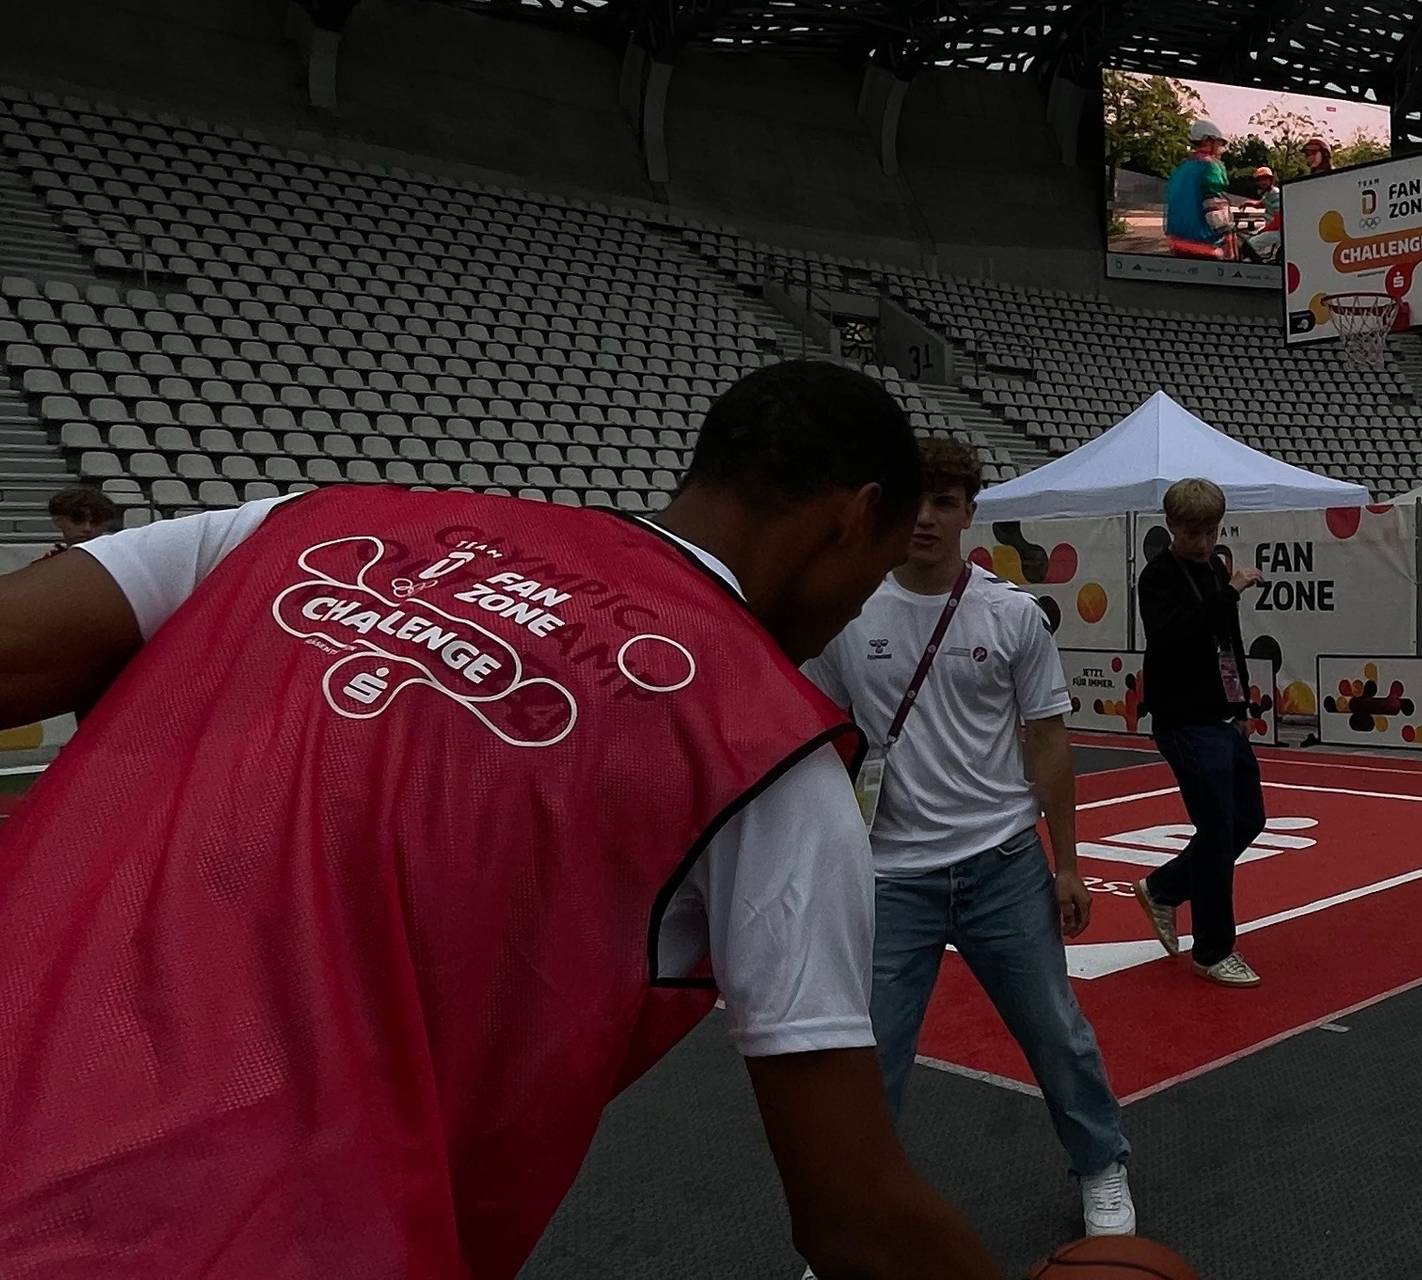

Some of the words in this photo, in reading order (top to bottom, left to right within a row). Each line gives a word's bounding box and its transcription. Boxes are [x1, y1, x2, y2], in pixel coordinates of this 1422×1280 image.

[1389, 179, 1421, 200] FAN
[1219, 526, 1239, 537] AM
[455, 540, 503, 558] TEAM
[1255, 541, 1313, 573] FAN
[486, 572, 573, 607] FAN
[1255, 580, 1335, 611] ZONE
[453, 583, 566, 638] ZONE
